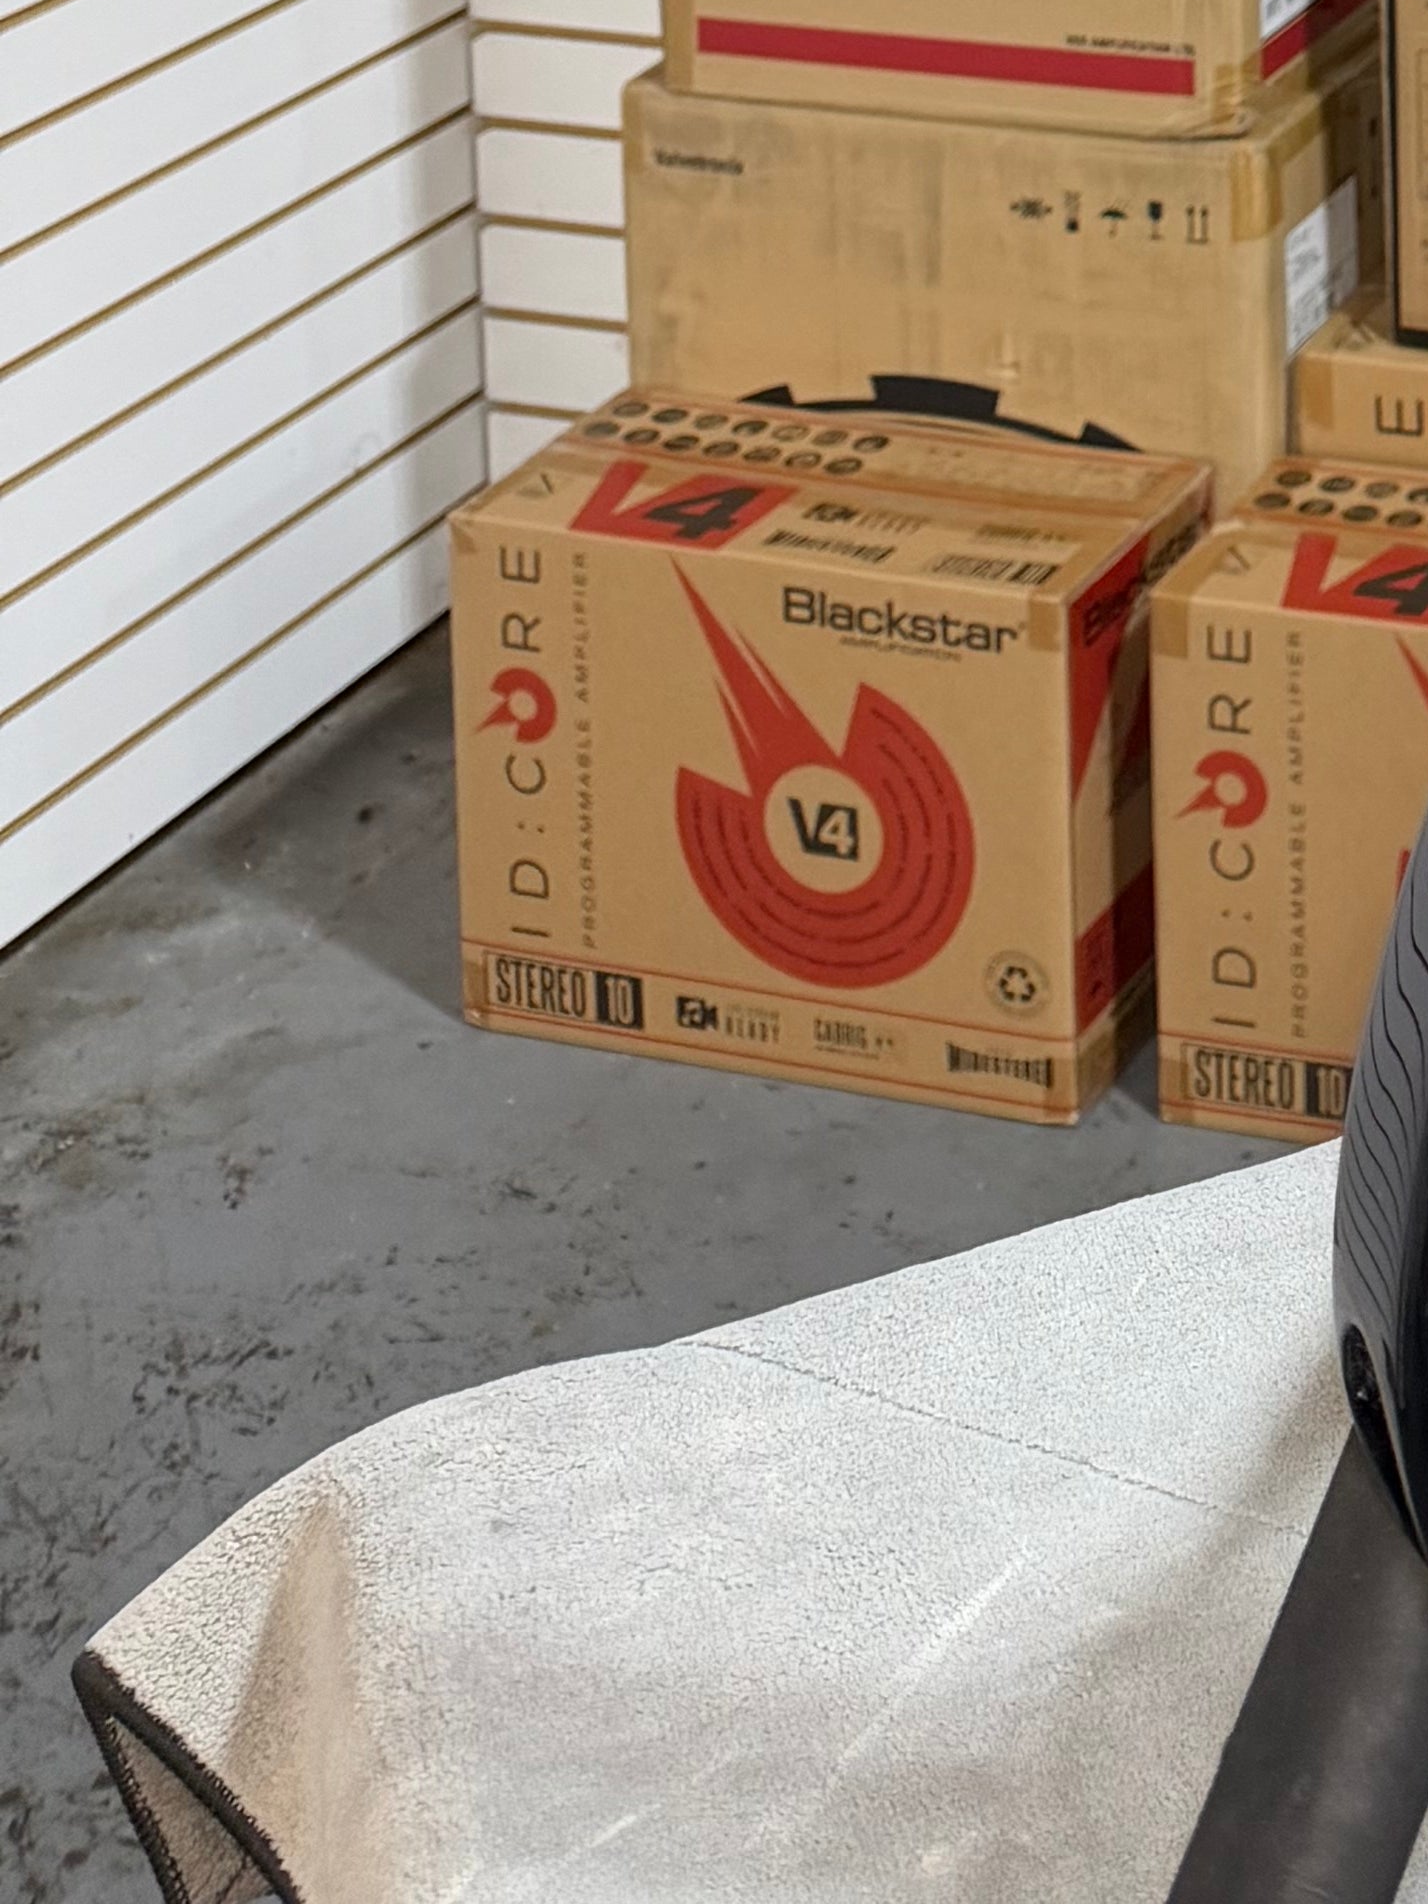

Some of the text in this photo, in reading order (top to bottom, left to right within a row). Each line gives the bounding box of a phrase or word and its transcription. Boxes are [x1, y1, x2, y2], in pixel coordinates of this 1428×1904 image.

[567, 459, 802, 552] V4
[781, 585, 1019, 655] Blackstar
[569, 550, 599, 950] PROGRAMMABLE AMPLIFIER
[786, 794, 861, 863] V4
[1284, 630, 1309, 1039] PROGRAMMABLE AMPLIFIER
[495, 958, 587, 1020] STEREO
[1193, 1049, 1297, 1111] STEREO
